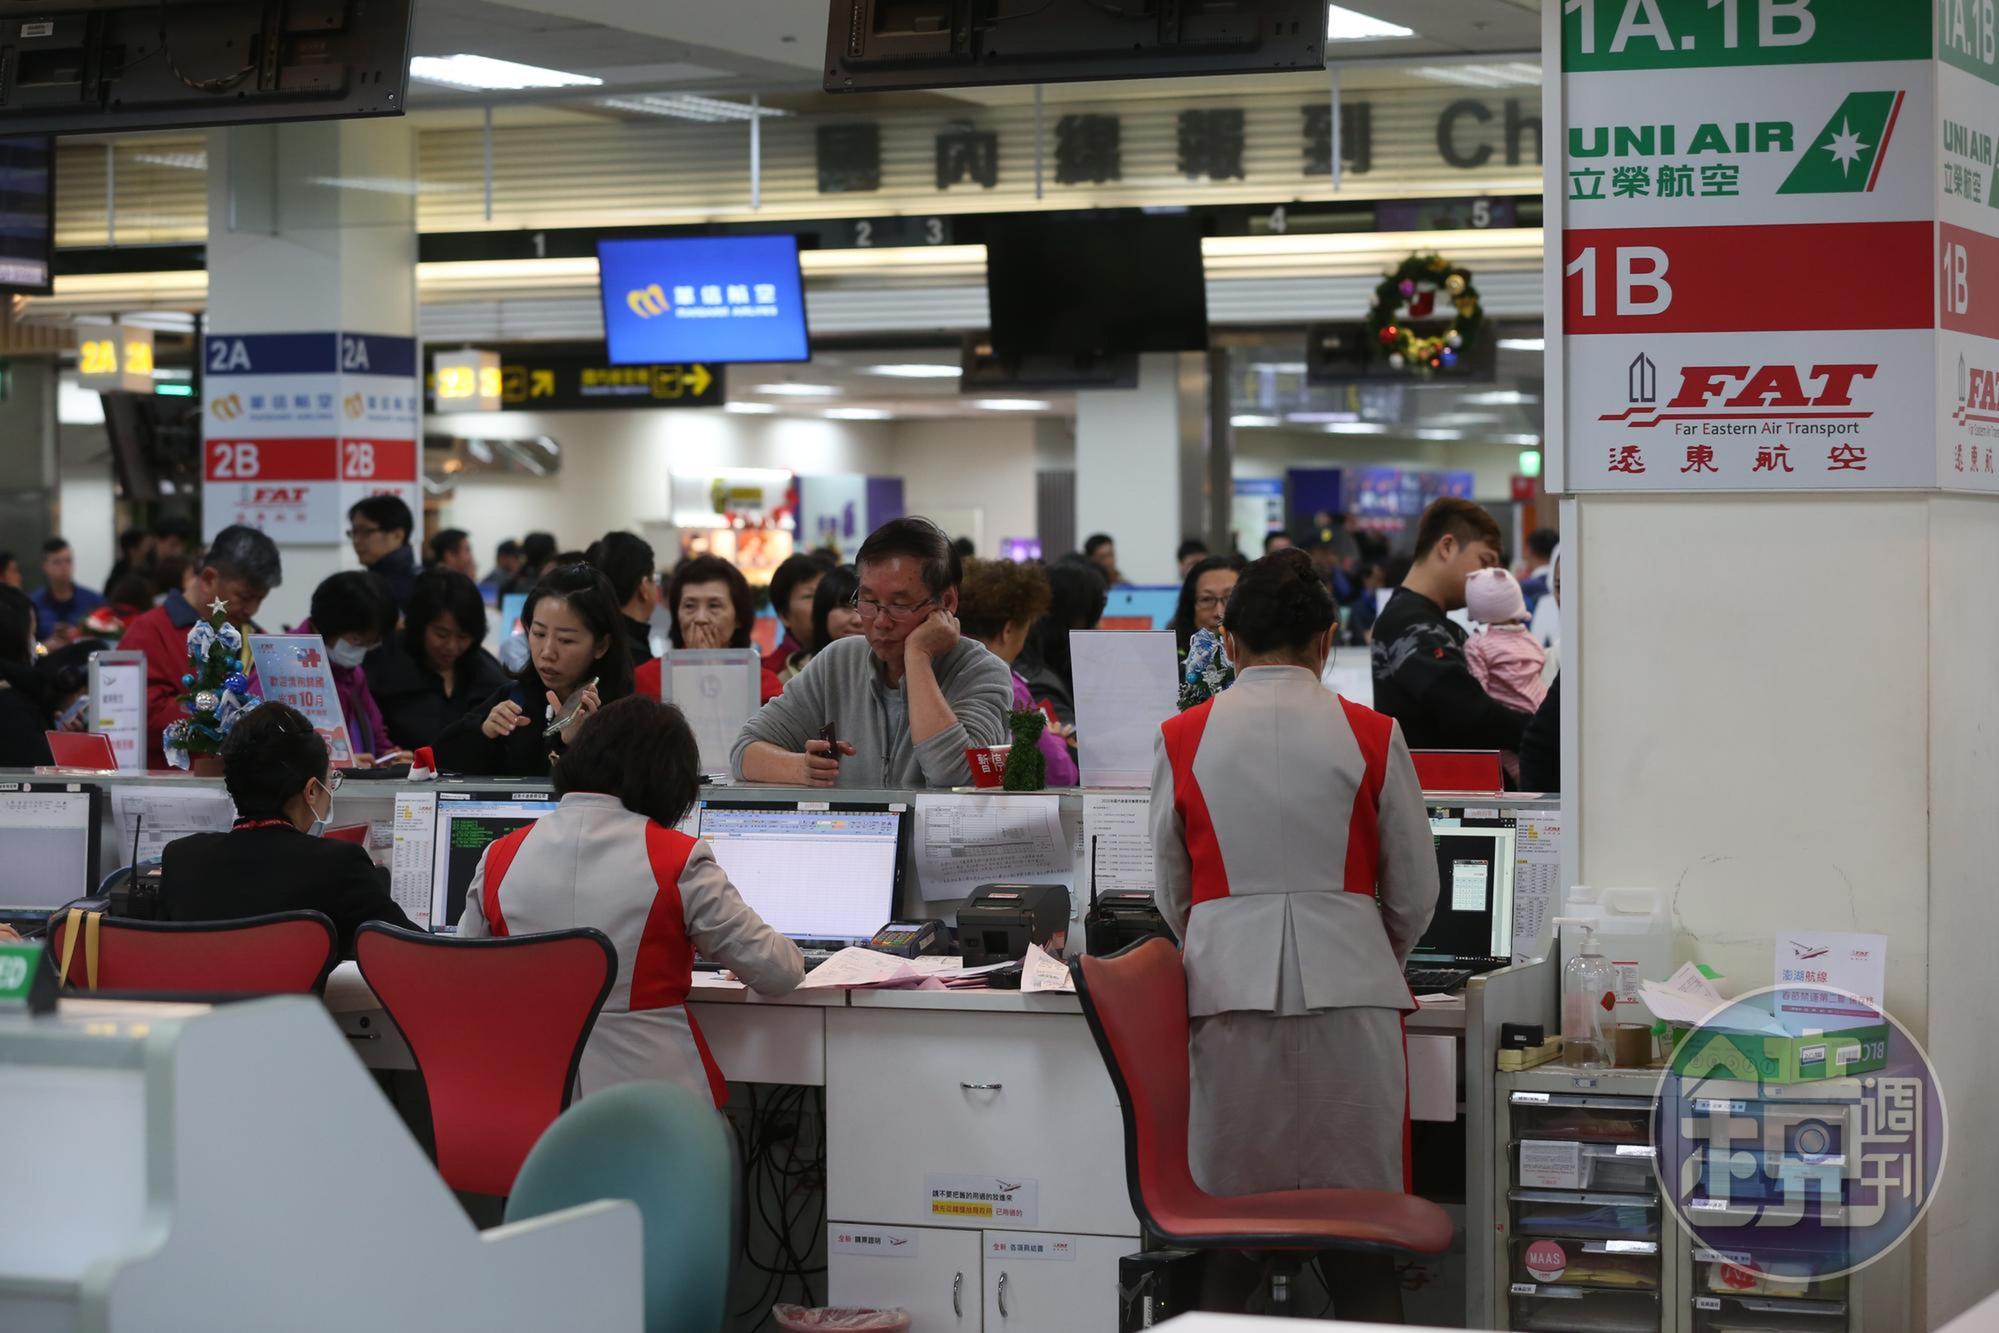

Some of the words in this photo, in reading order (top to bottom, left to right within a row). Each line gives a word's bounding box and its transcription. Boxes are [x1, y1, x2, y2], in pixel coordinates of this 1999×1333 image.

[1564, 0, 1816, 54] 1A.1B
[1568, 125, 1676, 158] UNI
[1686, 121, 1795, 155] AIR
[1943, 119, 1968, 158] UNI
[1969, 129, 1992, 166] AIR
[1568, 163, 1740, 201] 立榮航空
[926, 218, 943, 244] 3
[1267, 205, 1287, 233] 4
[1472, 201, 1491, 228] 5
[532, 232, 547, 259] 1
[855, 222, 873, 247] 2
[1565, 245, 1674, 318] 1B
[1943, 241, 1968, 316] 1B
[209, 339, 252, 371] 2A
[343, 338, 370, 369] 2A
[1666, 364, 1879, 408] FAT
[1675, 422, 1698, 435] Far
[1702, 422, 1757, 435] Eastern
[1761, 421, 1782, 434] Air
[1787, 421, 1860, 438] Transport
[213, 443, 260, 478] 2B
[345, 442, 376, 478] 2B
[1529, 1252, 1561, 1265] MAAS
